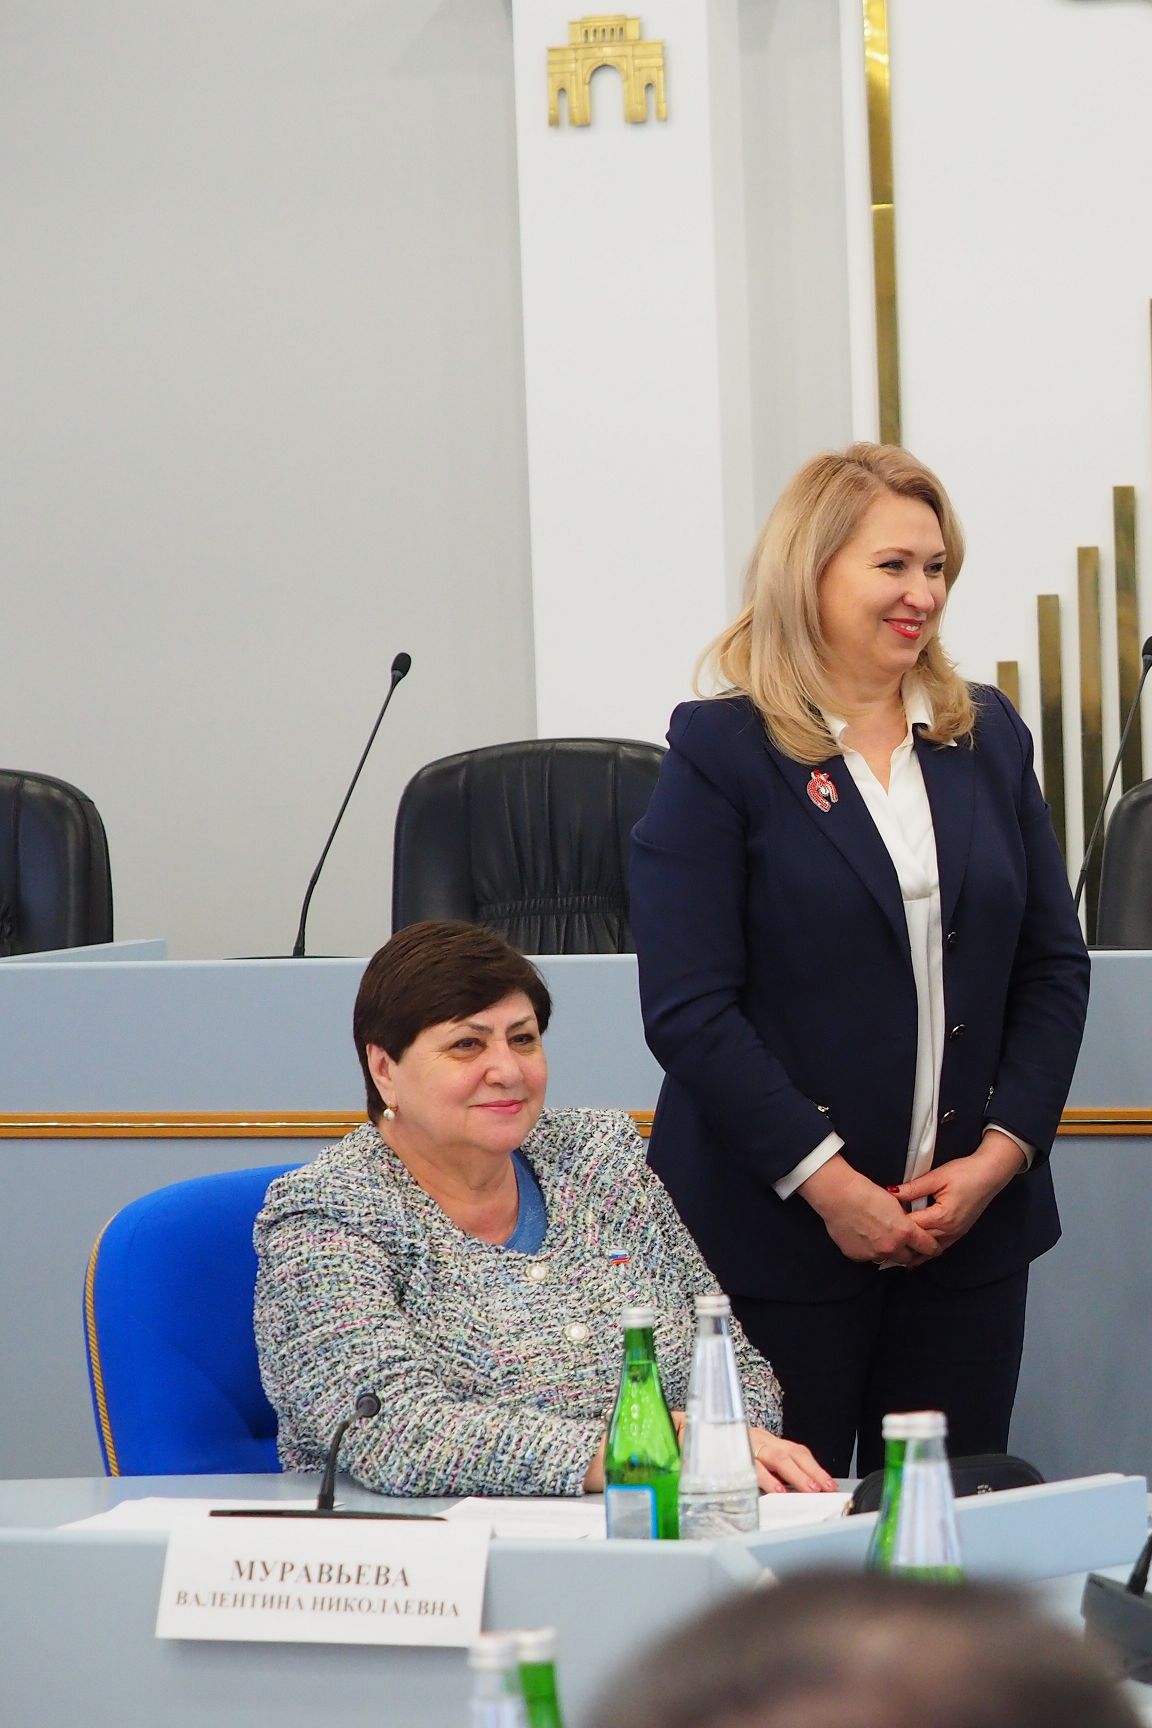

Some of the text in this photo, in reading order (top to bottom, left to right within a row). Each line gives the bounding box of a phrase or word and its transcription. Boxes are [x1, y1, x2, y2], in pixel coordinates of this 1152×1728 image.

[231, 1559, 410, 1587] МУРАВЬЕВА
[175, 1590, 460, 1617] ВАЛЕНТИНА НИКОЛАЕВНА
